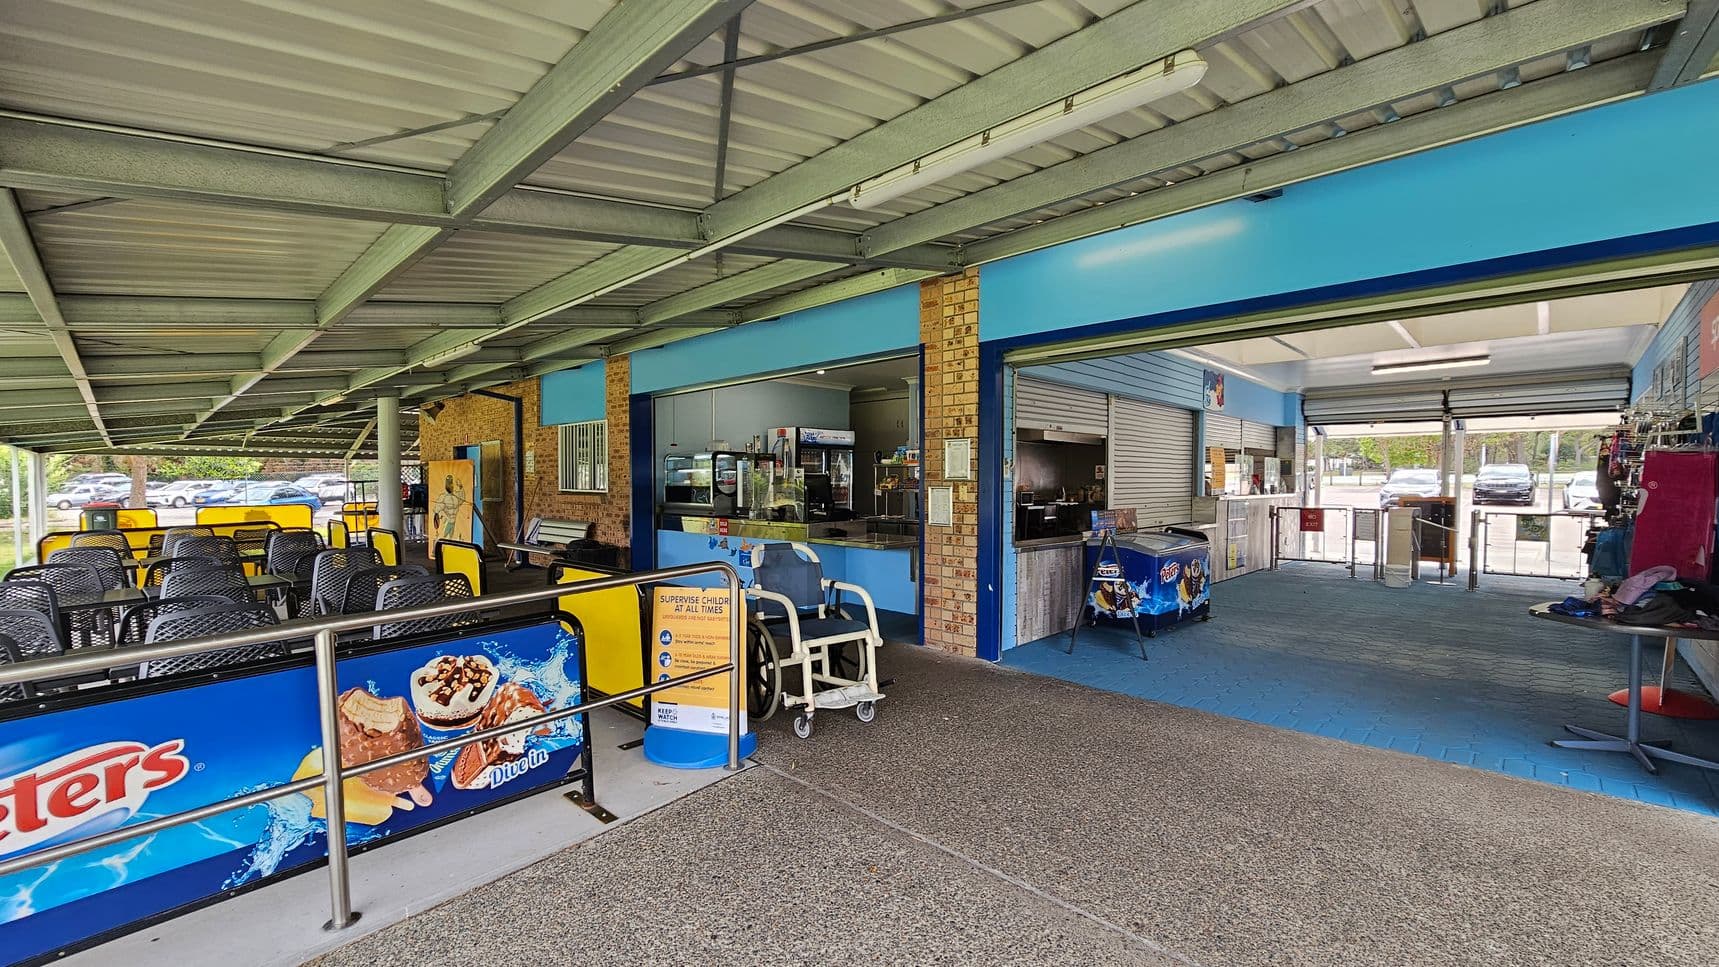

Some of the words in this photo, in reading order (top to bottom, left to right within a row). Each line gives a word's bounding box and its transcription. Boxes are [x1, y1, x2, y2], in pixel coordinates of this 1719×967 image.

[660, 595, 700, 604] SUPERVISE
[702, 596, 729, 605] CHILDR
[686, 605, 698, 613] ALL
[701, 605, 723, 614] TIMES
[489, 757, 528, 789] Dive
[529, 749, 549, 769] in
[0, 742, 186, 841] ters
